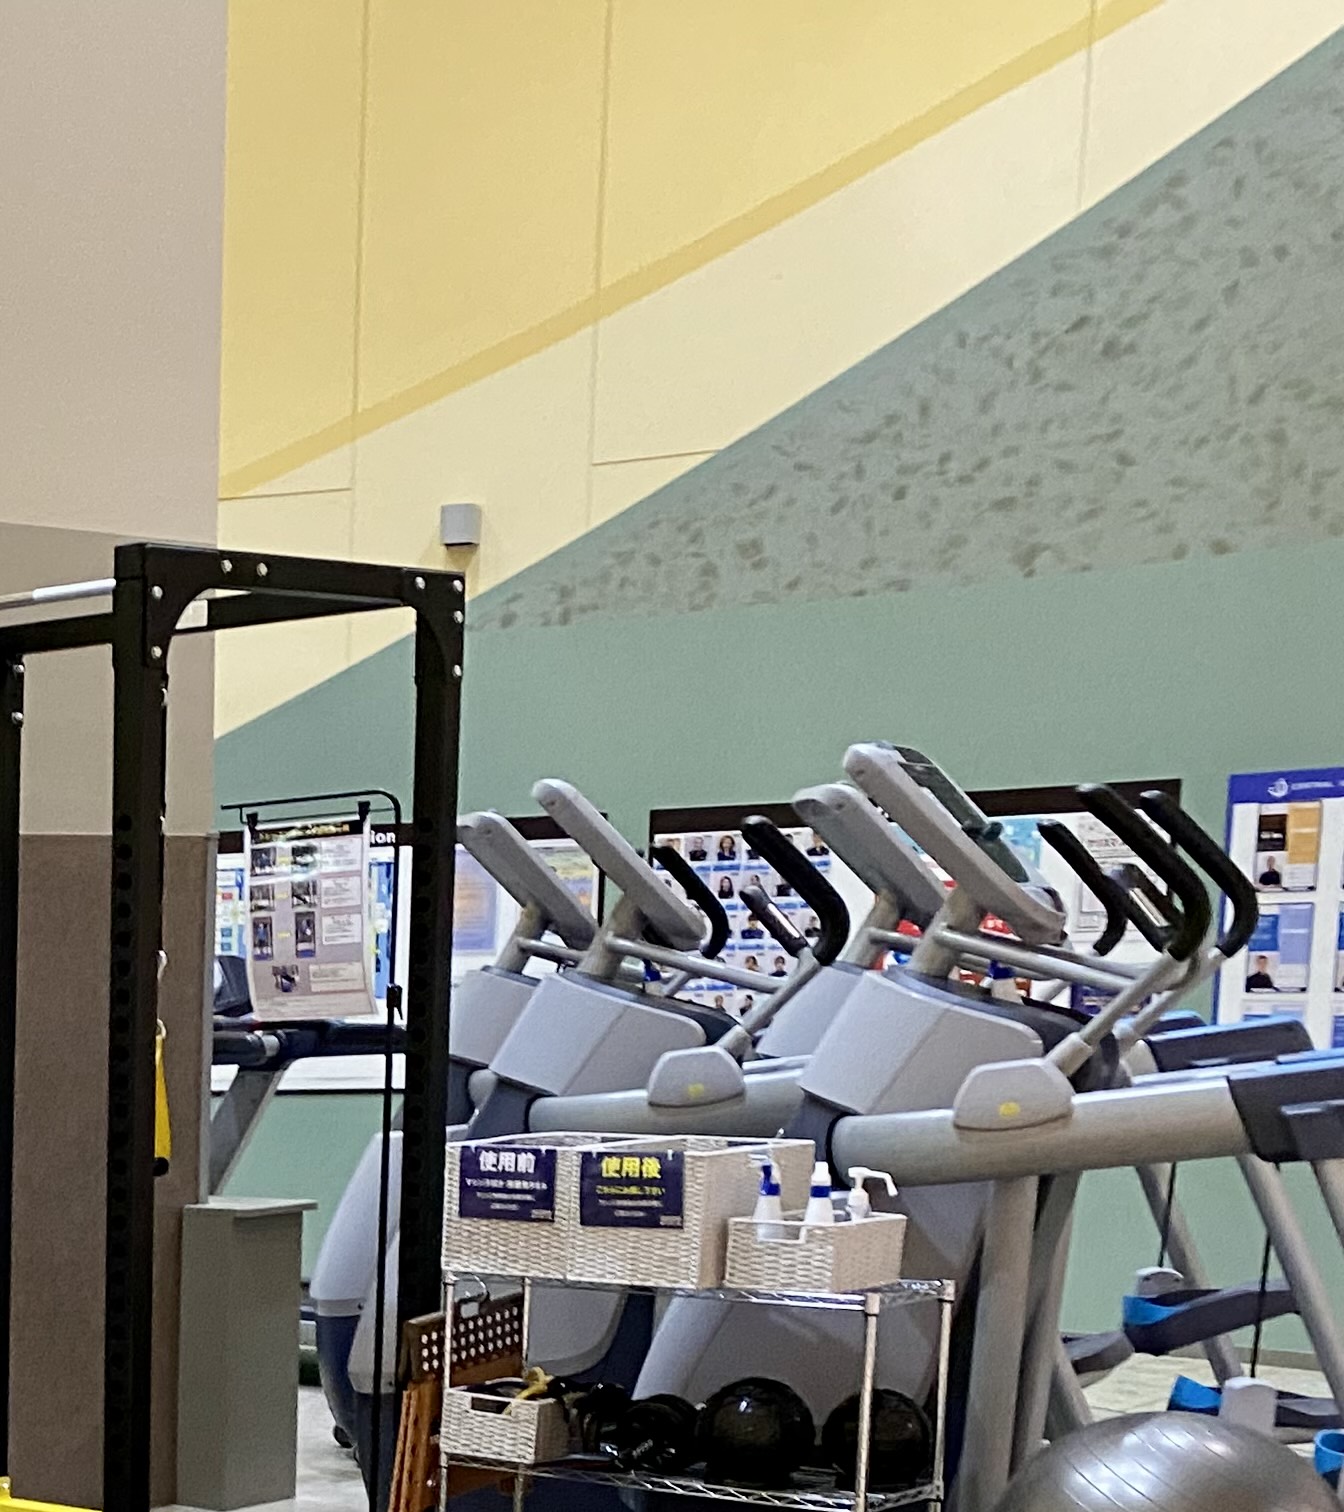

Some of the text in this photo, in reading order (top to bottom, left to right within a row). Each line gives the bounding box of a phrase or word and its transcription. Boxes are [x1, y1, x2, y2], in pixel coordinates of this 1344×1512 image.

[479, 1150, 536, 1174] 使用前
[601, 1156, 662, 1179] 使用後
